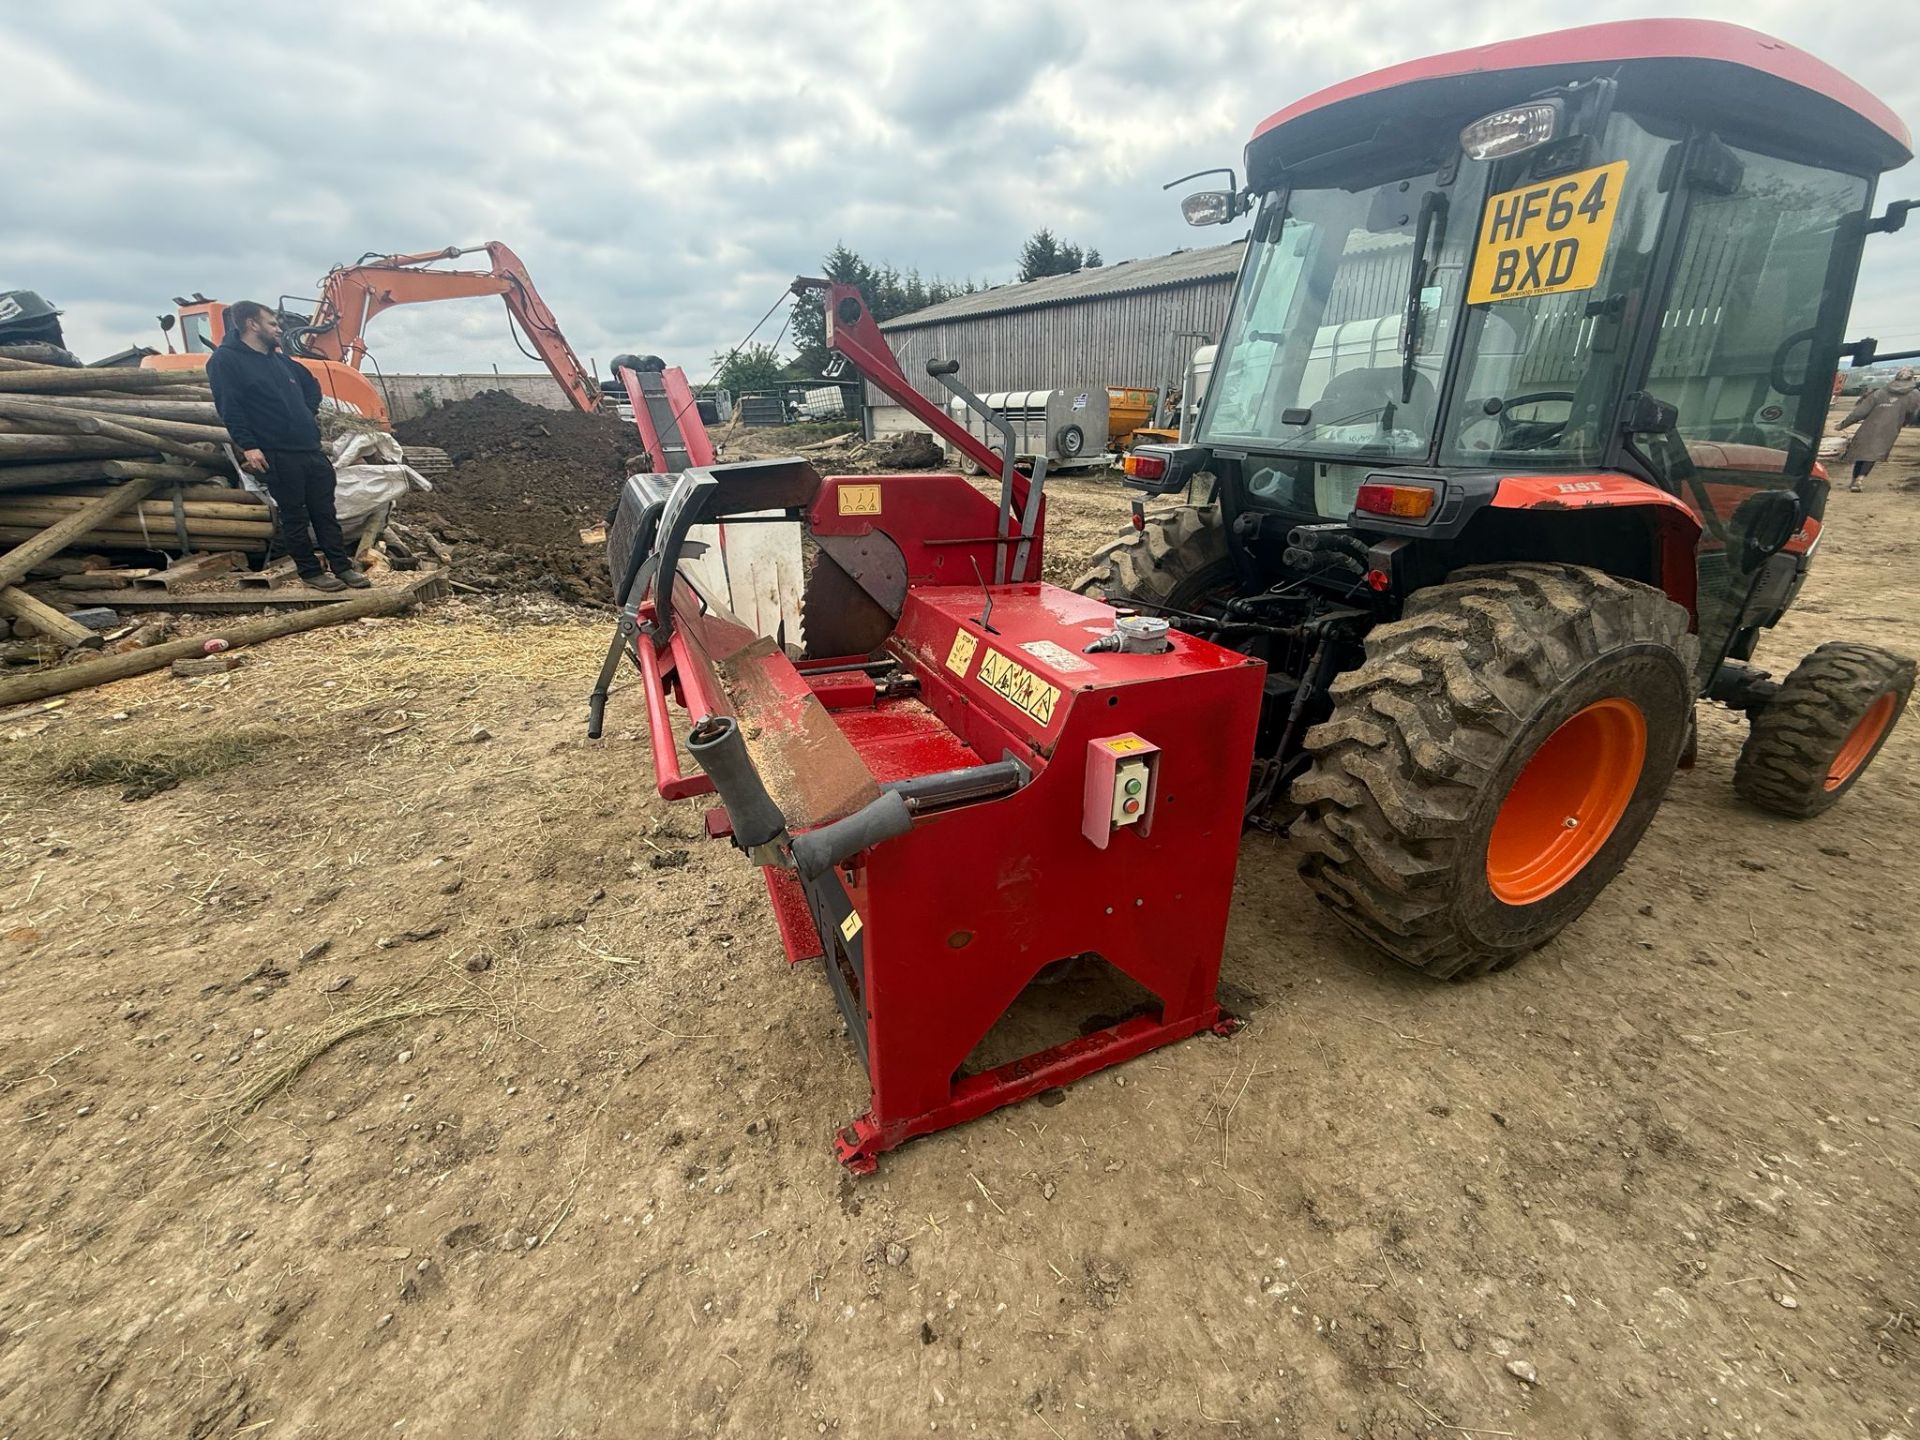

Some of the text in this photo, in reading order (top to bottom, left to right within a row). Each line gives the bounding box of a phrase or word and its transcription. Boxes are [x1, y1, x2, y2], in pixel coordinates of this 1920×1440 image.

[1489, 172, 1608, 244] HF64
[1490, 238, 1579, 294] BXD
[1558, 481, 1603, 494] HST
